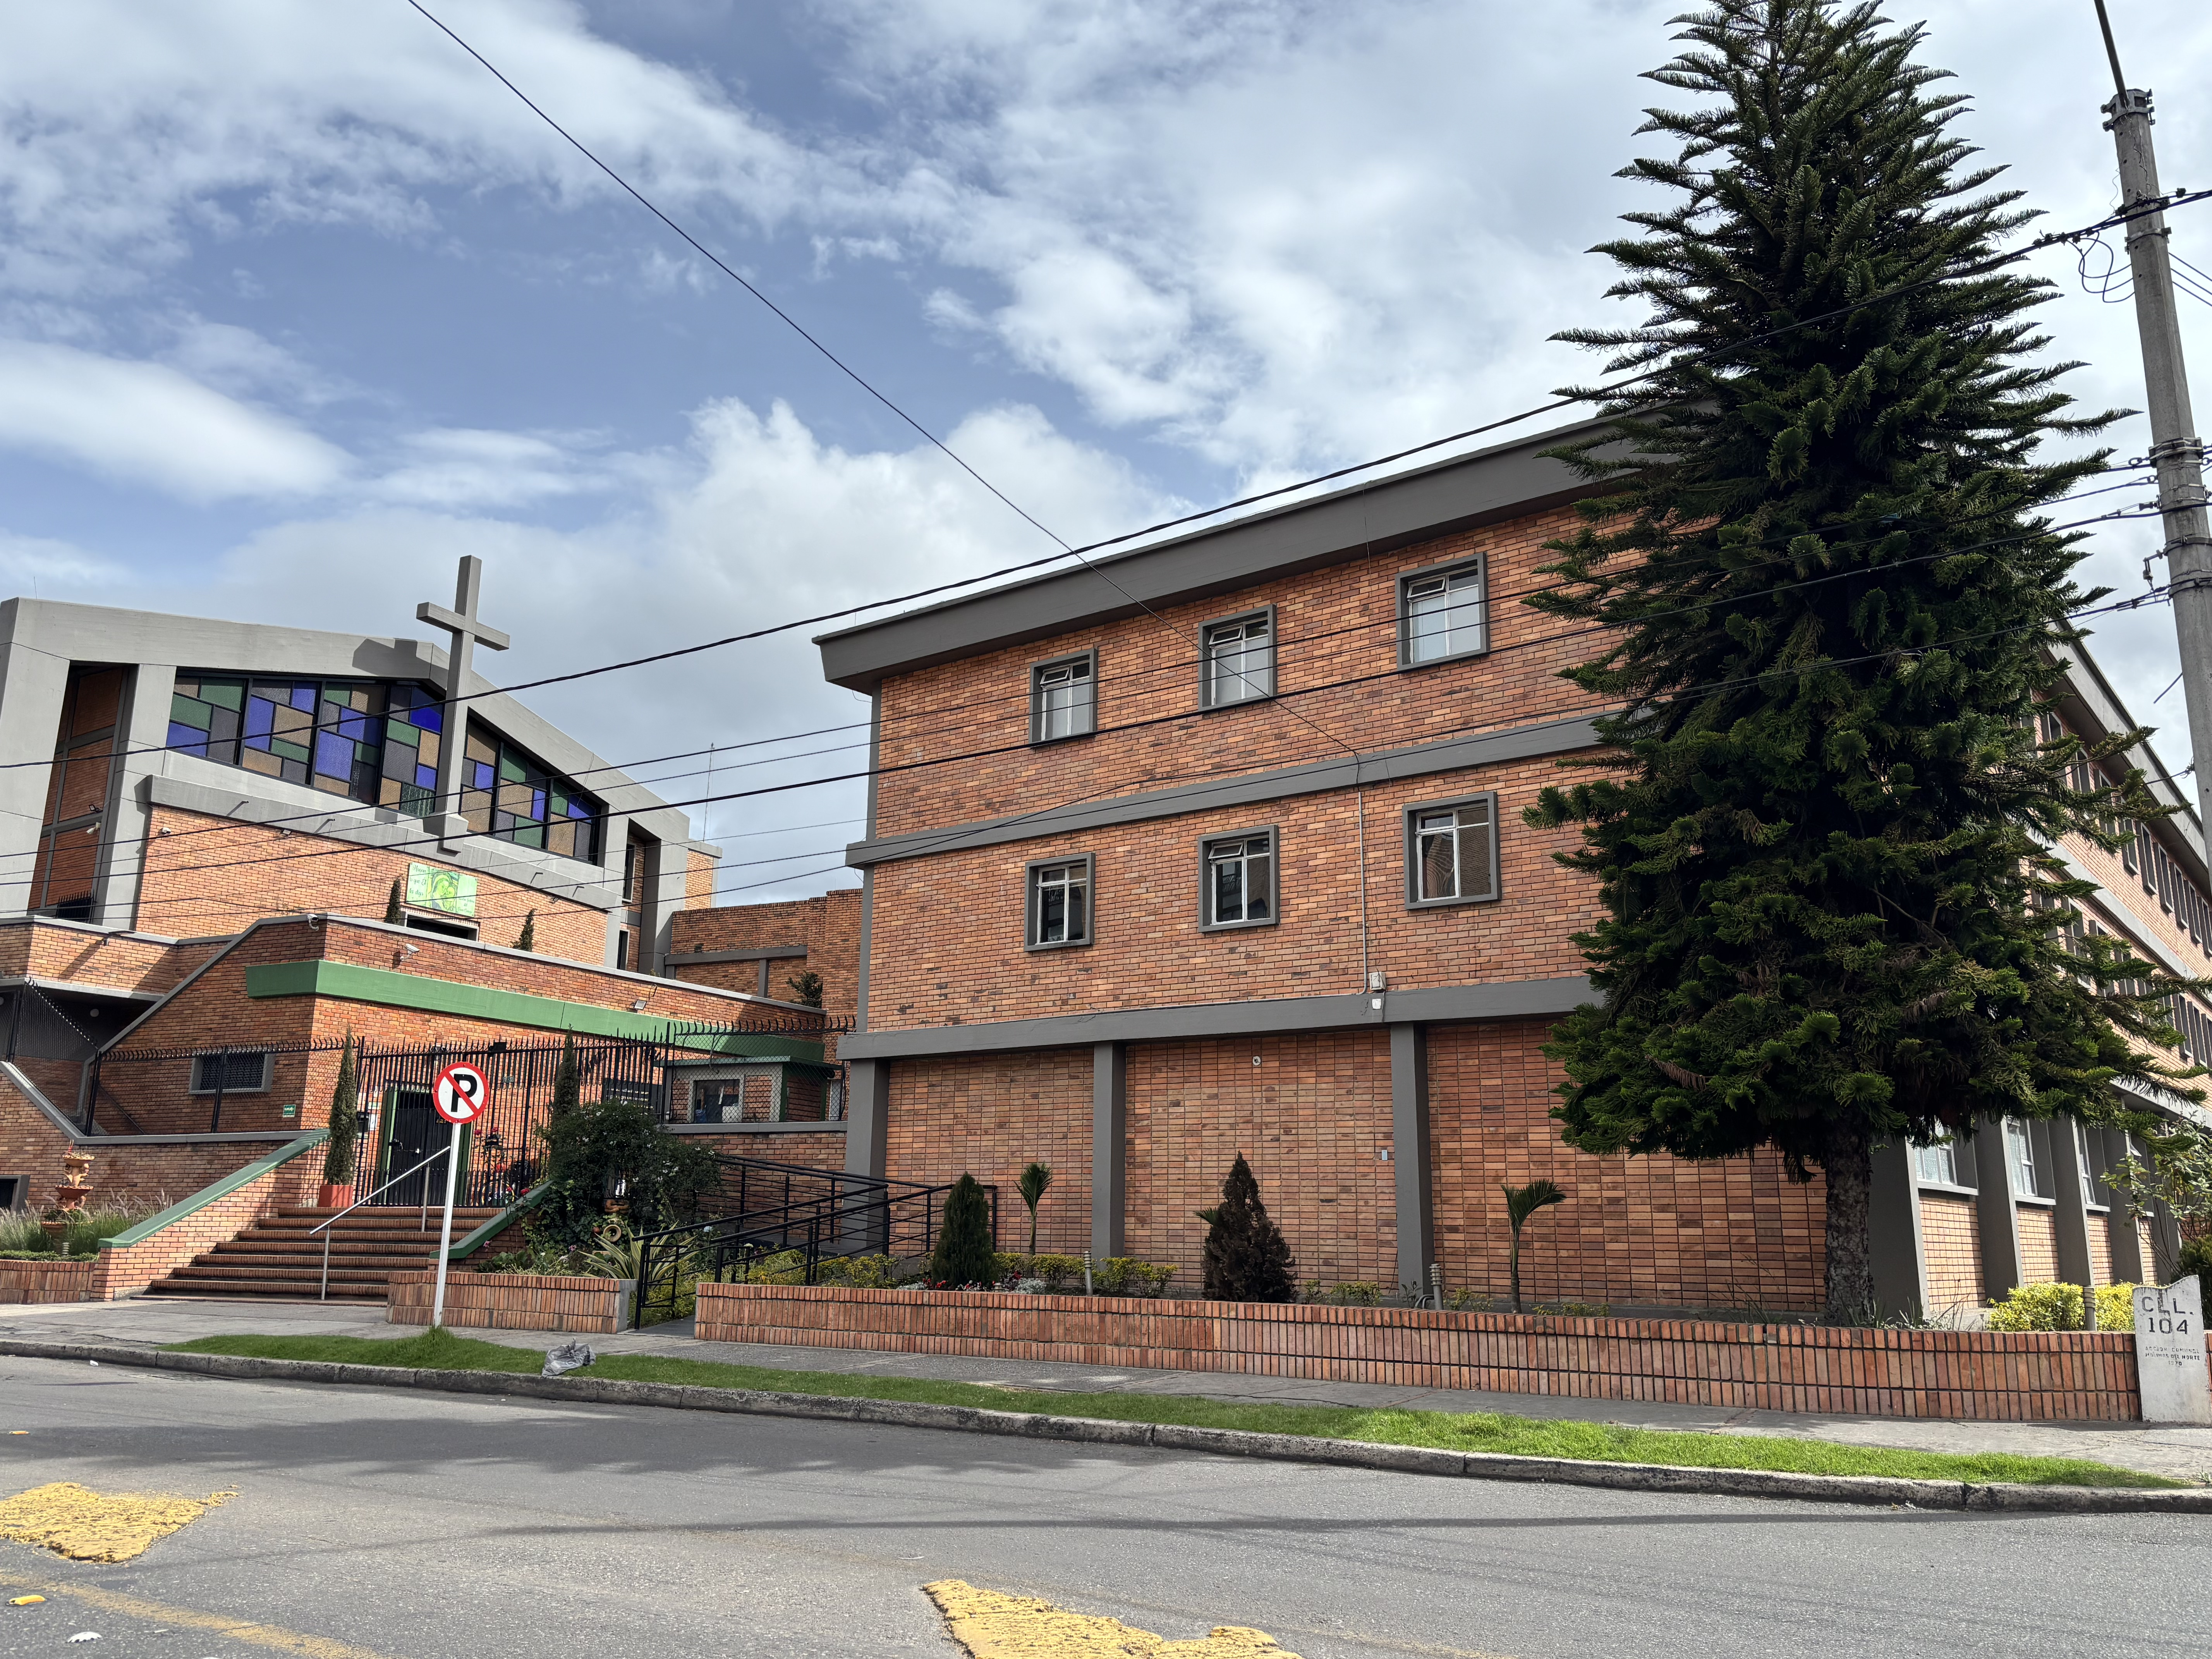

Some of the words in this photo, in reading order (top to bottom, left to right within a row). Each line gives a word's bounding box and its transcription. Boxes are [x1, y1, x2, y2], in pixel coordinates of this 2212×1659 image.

[451, 1073, 477, 1112] P
[2142, 1297, 2194, 1315] CLL.
[2149, 1317, 2188, 1334] 104
